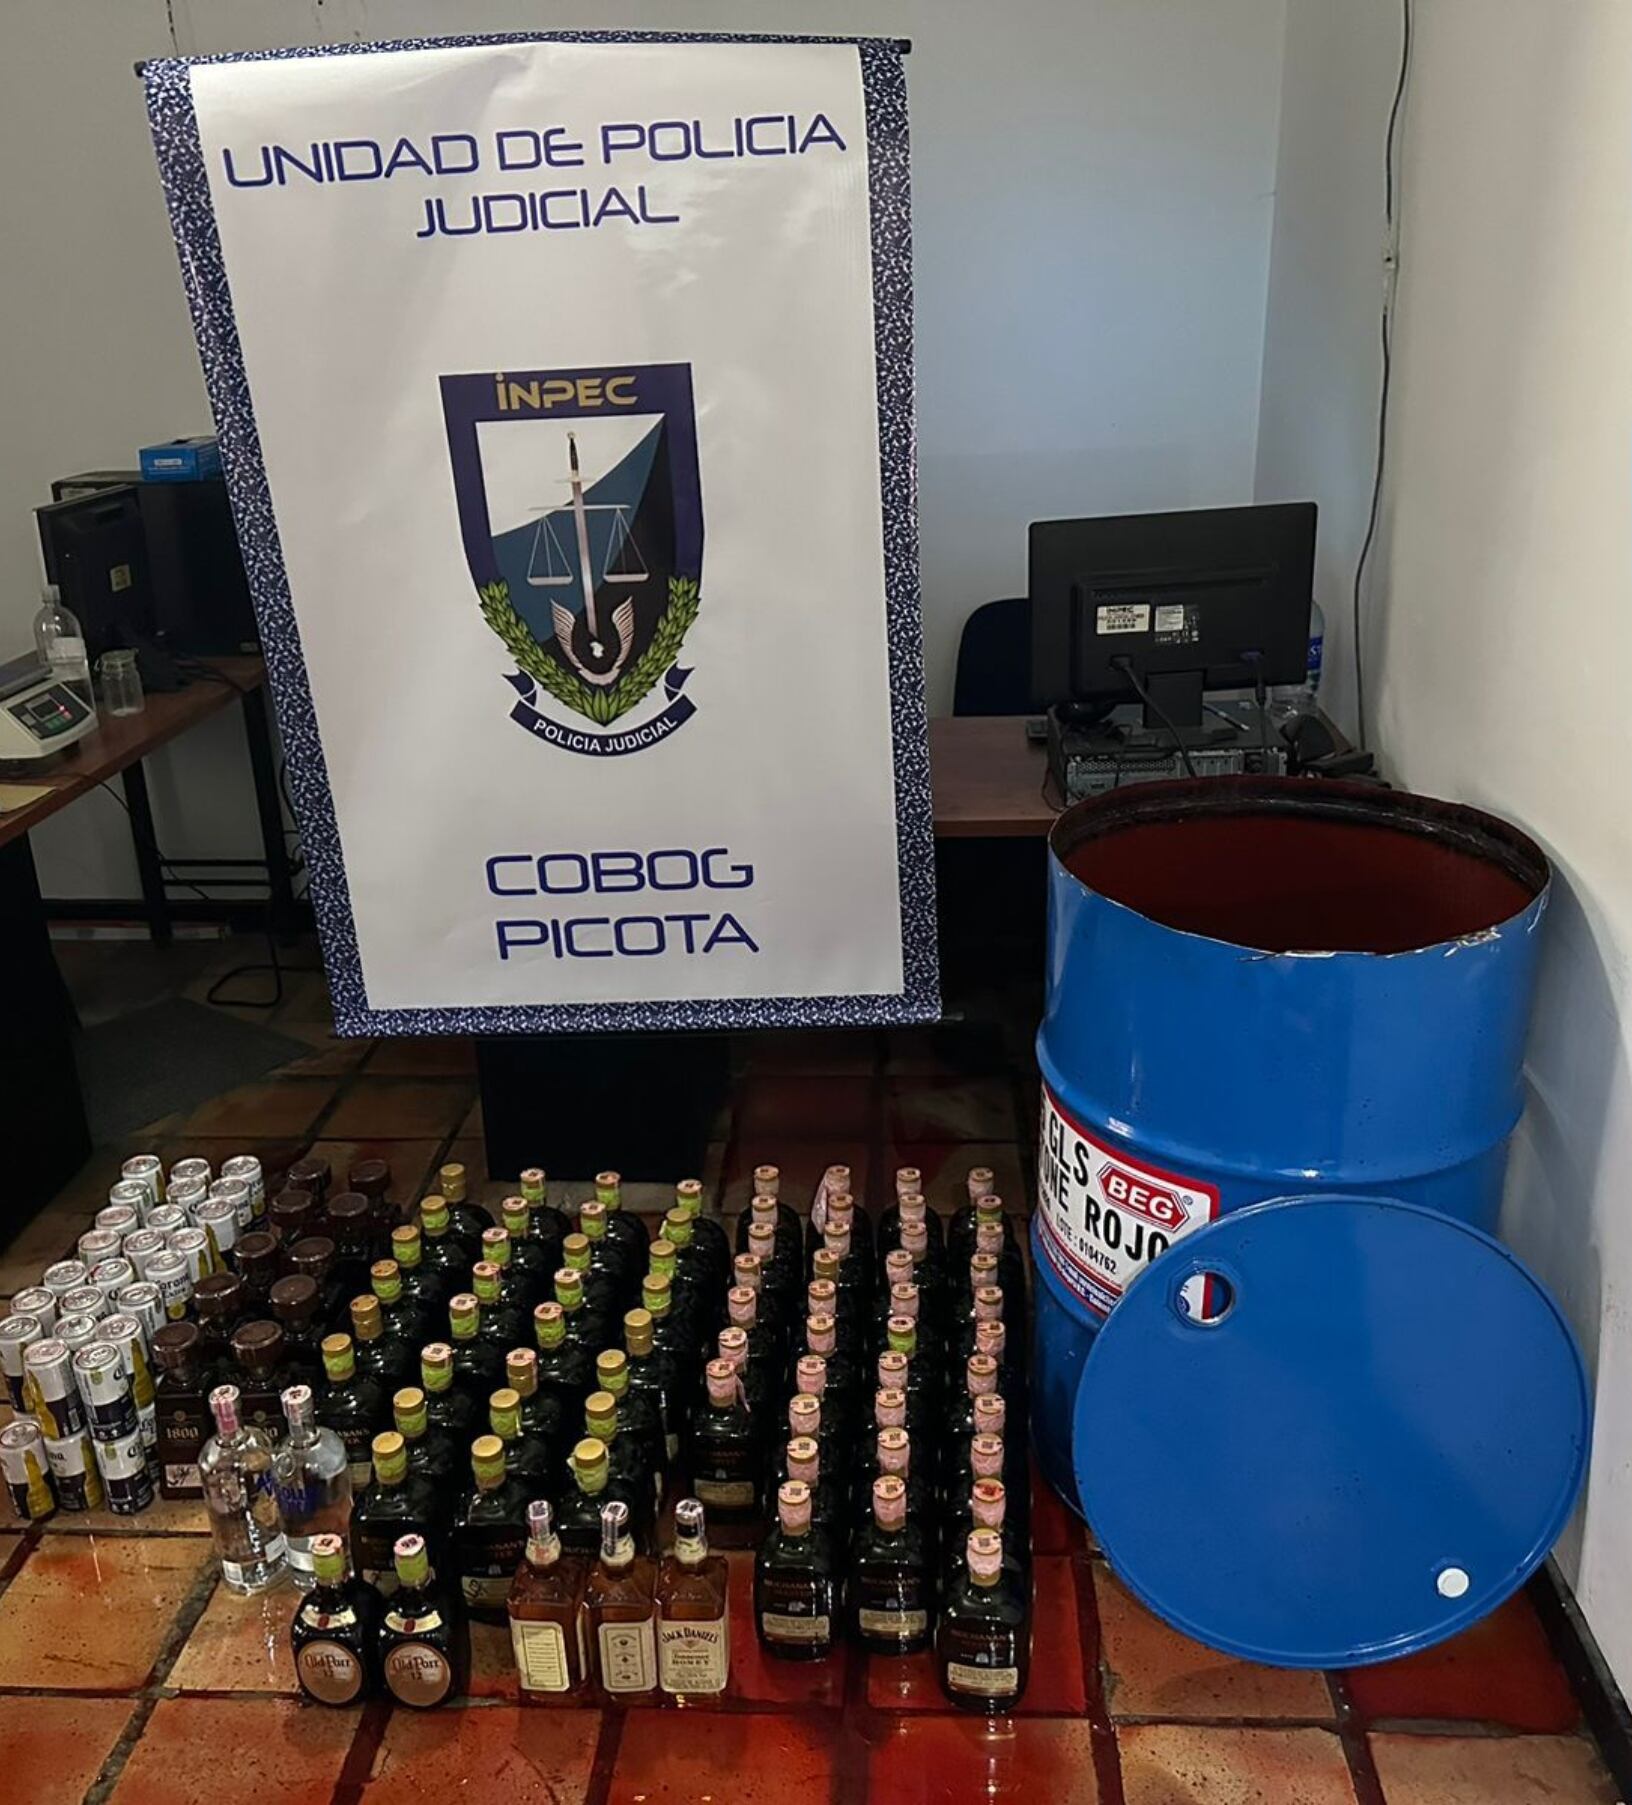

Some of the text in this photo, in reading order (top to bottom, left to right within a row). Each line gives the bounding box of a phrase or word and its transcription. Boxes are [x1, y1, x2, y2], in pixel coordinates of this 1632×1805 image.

[222, 112, 847, 188] UNIDAD DE POLICIA
[416, 184, 681, 238] JUDICIAL
[533, 716, 678, 753] POLICIA JUDICIAL
[485, 847, 755, 896] COBOG
[495, 912, 760, 961] PICOTA
[1107, 1174, 1174, 1220] BEG
[1085, 1193, 1169, 1263] ROJO
[166, 1426, 199, 1439] 1800
[662, 1630, 683, 1644] JACK
[305, 1653, 349, 1669] Old Parr
[392, 1656, 439, 1673] Old Parr
